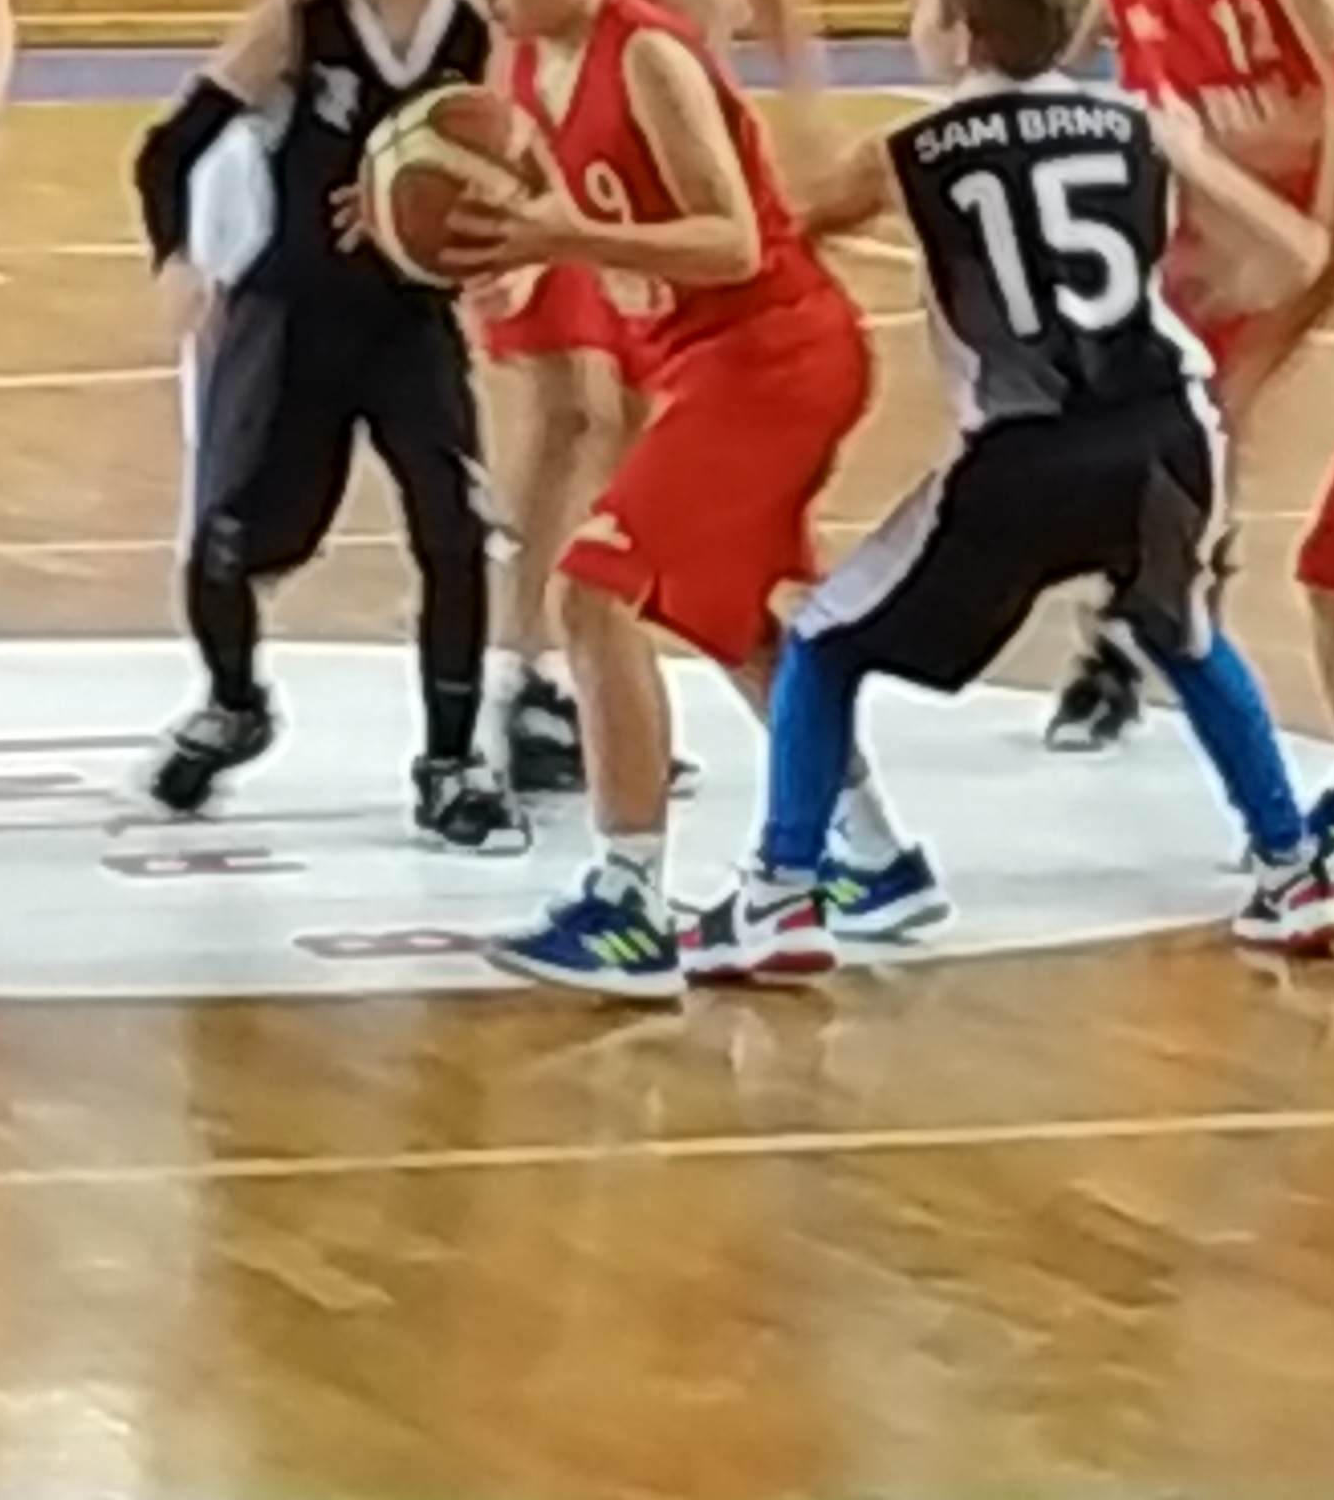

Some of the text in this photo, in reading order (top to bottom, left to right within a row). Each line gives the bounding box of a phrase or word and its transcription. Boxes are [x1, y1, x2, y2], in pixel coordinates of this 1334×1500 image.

[914, 104, 1133, 164] SAM BRNO
[950, 152, 1140, 337] 15
